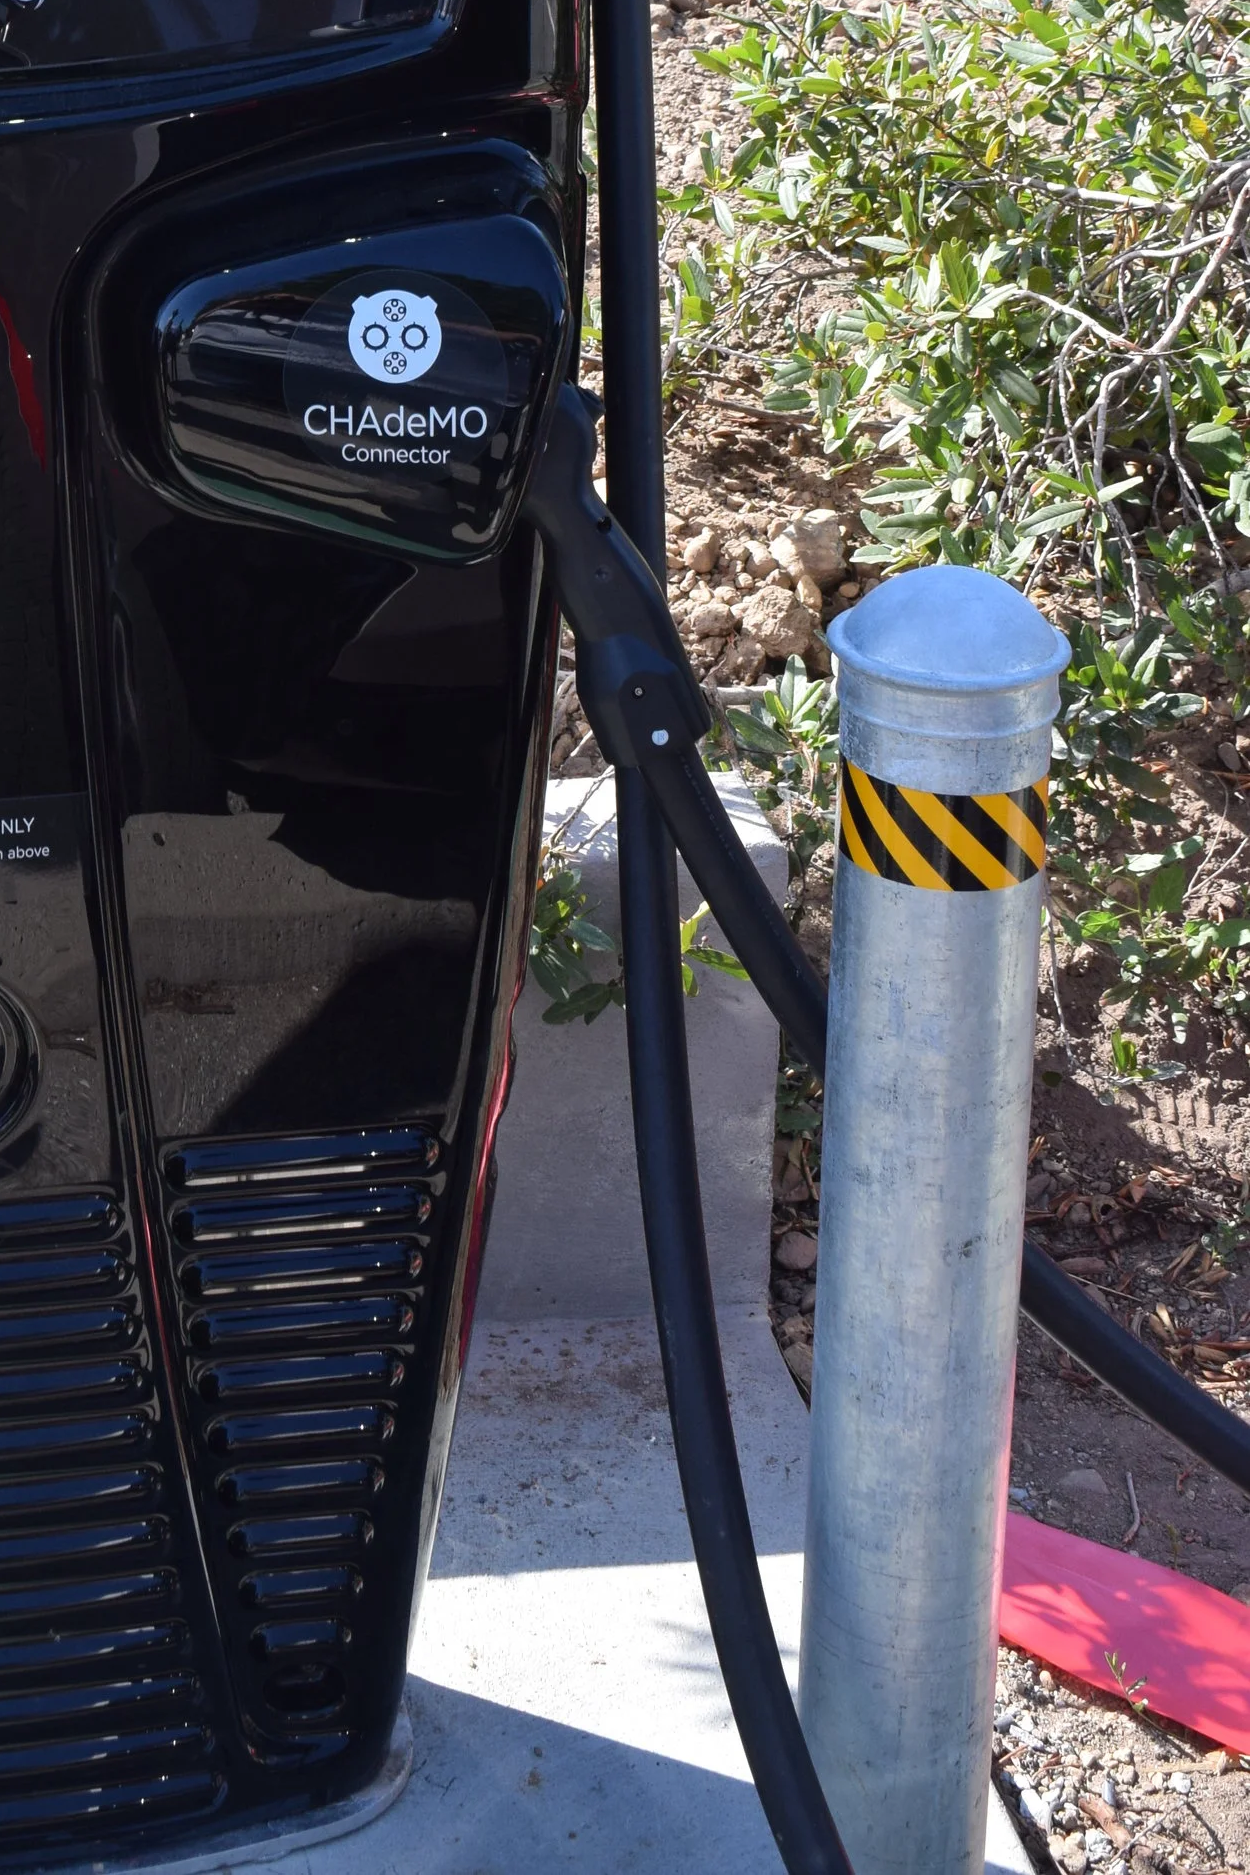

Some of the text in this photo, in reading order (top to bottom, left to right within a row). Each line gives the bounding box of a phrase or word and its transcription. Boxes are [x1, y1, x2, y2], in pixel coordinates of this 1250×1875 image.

[303, 404, 488, 439] CHAdeMO
[341, 443, 451, 465] Connector
[7, 846, 50, 860] above
